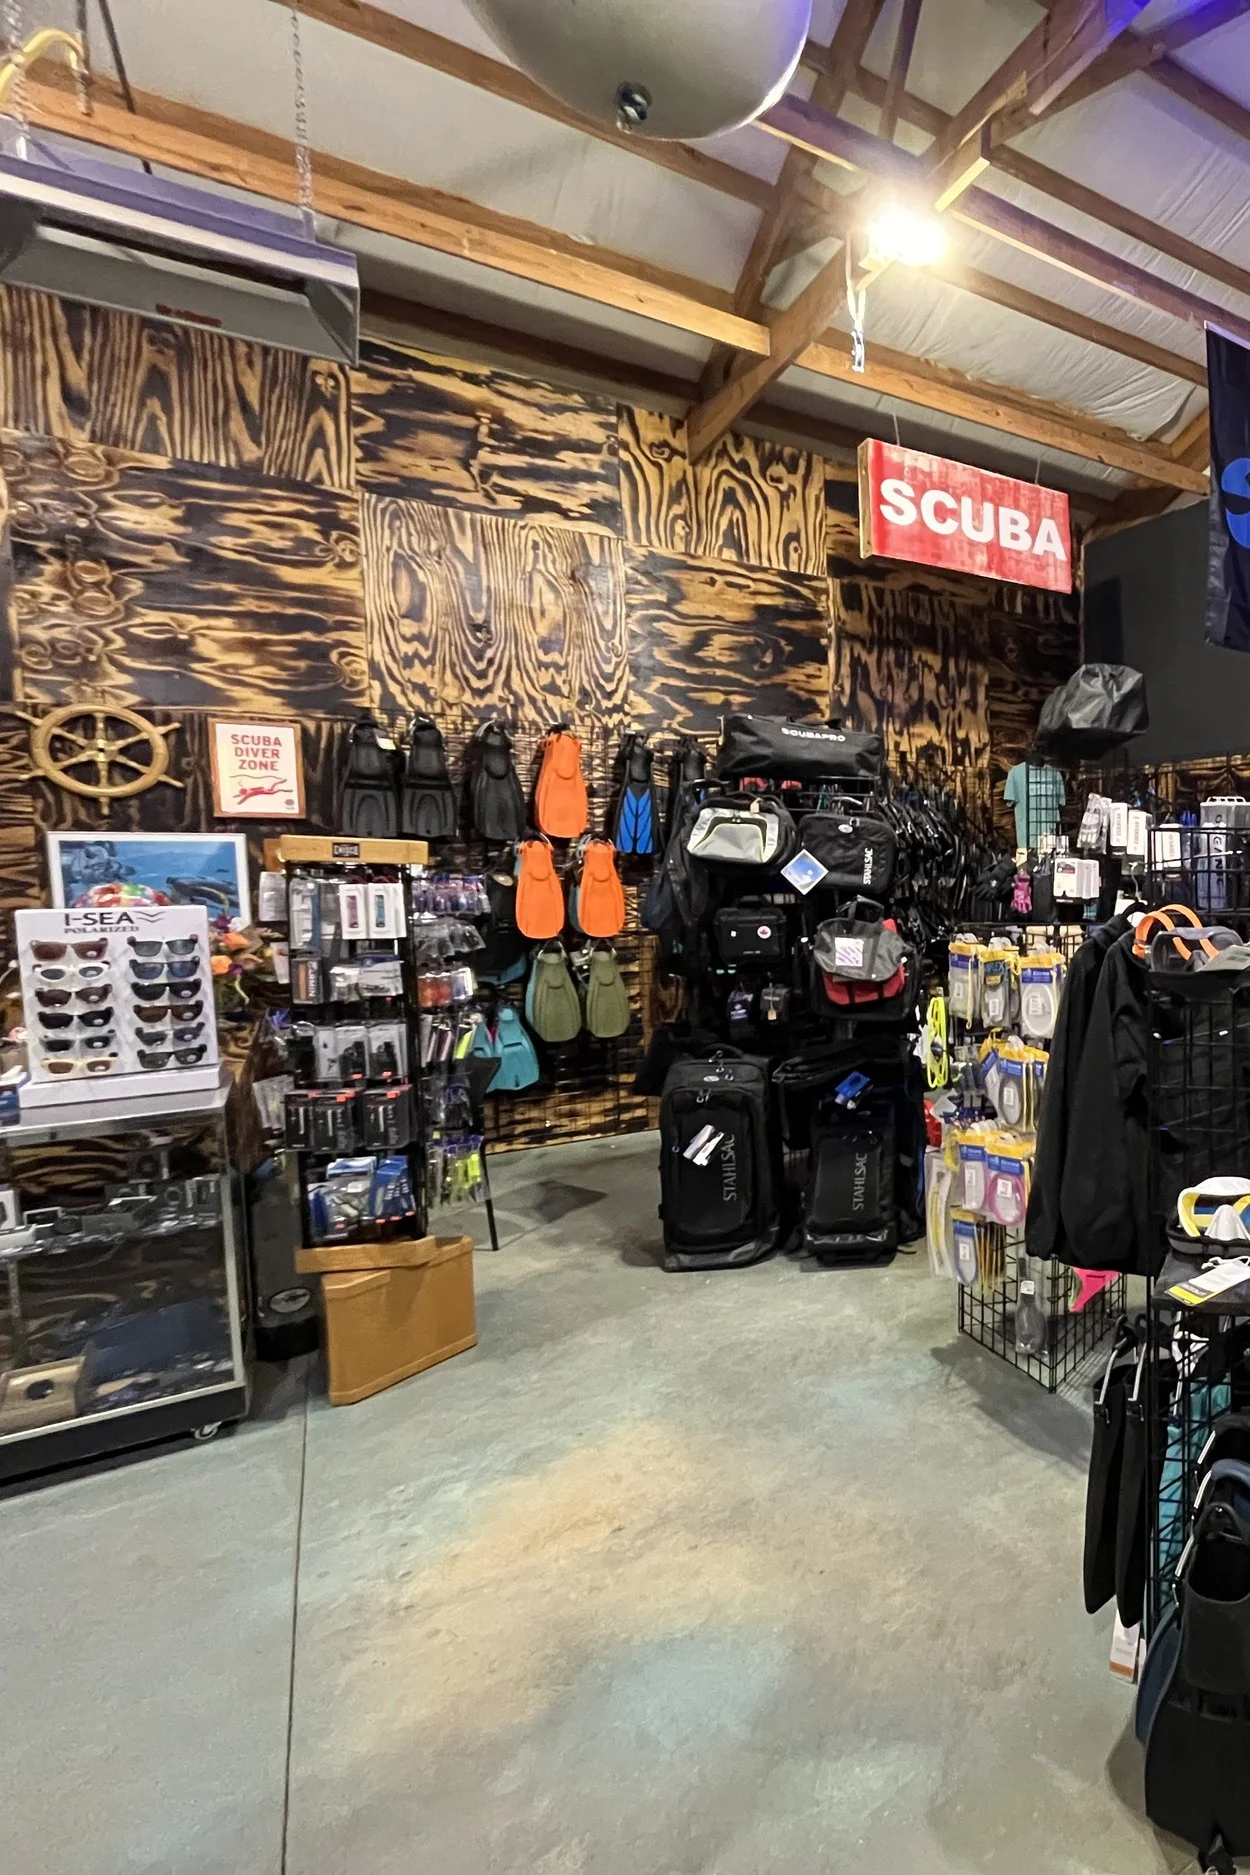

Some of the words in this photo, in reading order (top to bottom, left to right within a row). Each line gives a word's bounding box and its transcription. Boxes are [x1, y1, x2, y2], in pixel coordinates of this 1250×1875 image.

[879, 478, 1068, 561] SCUBA
[231, 733, 283, 747] SCUBA
[781, 727, 846, 742] SCUBAPRO
[234, 746, 281, 760] DIVER
[238, 759, 279, 772] ZONE
[863, 847, 874, 886] STAHLSAC
[64, 911, 135, 926] I-SEA
[64, 926, 140, 934] POLARIZED
[308, 961, 319, 998] GARMIN
[721, 1134, 737, 1201] STAHLSAC
[852, 1153, 868, 1210] STAHLSAC
